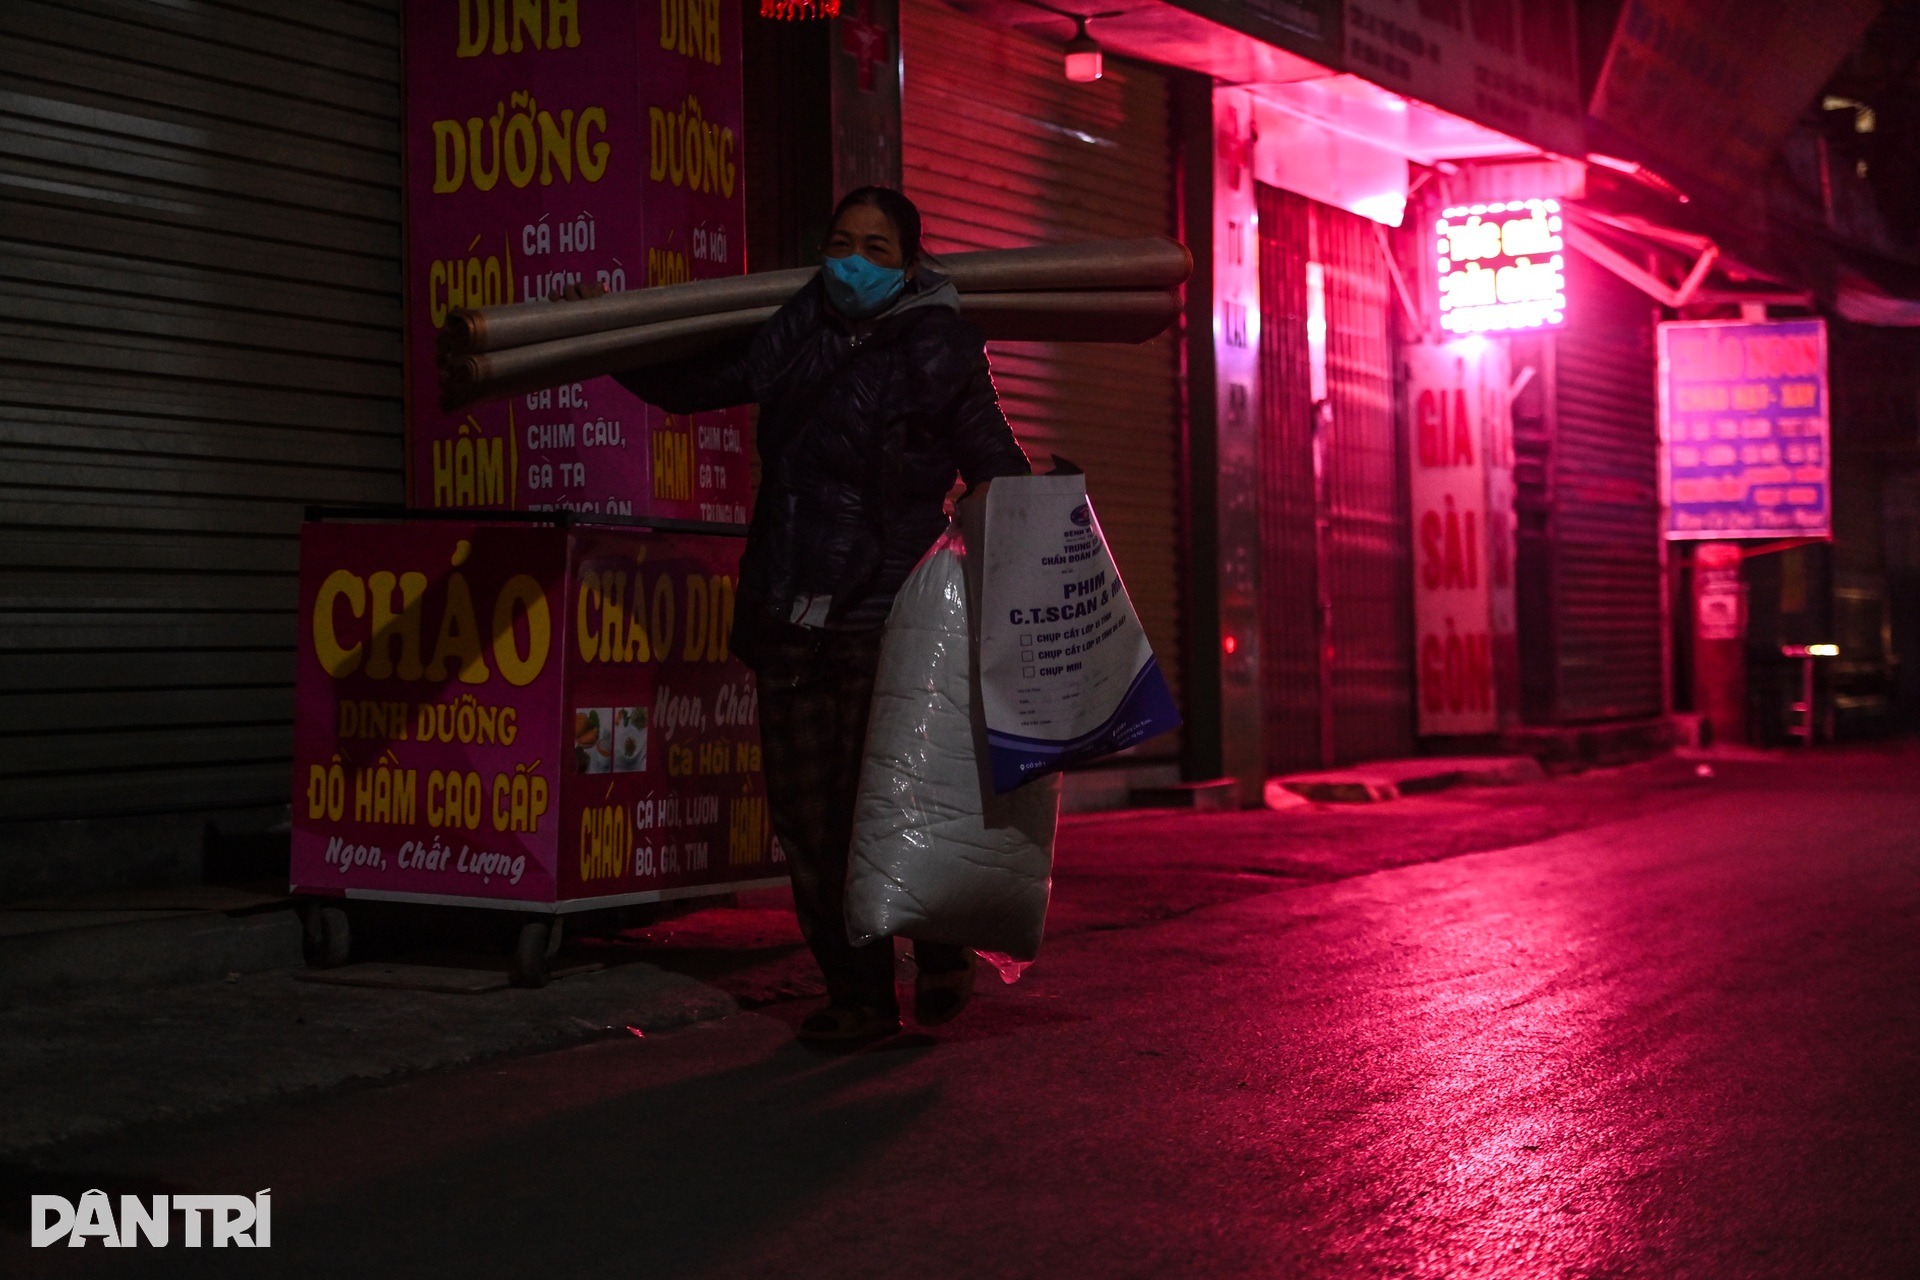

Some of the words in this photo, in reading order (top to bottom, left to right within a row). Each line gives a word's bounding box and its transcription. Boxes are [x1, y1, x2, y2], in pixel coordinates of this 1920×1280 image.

[432, 89, 611, 194] DƯỠNG
[649, 94, 736, 199] DƯỠNG
[522, 212, 550, 256] CÁ
[559, 210, 596, 252] HỒI
[693, 220, 707, 260] CÁ
[527, 423, 576, 450] CHIM
[583, 416, 626, 449] CÂU,
[433, 414, 505, 508] HẦM
[528, 455, 553, 490] GÀ
[559, 462, 586, 488] TA
[713, 465, 726, 490] TA
[1064, 542, 1091, 554] TRUNG
[577, 544, 676, 664] CHÁO
[683, 573, 738, 664] DIN
[1064, 570, 1105, 599] PHIM
[312, 539, 550, 687] CHÁO
[1010, 596, 1097, 625] C.T.SCAN
[1101, 590, 1109, 606] &
[1037, 633, 1061, 643] CHỤP
[1038, 649, 1062, 660] CHỤP
[1039, 666, 1064, 676] CHỤP
[1066, 661, 1082, 673] MRI
[339, 700, 408, 741] DINH
[416, 693, 518, 746] DƯỠNG
[653, 685, 707, 741] Ngon,
[306, 747, 348, 822] ĐỒ
[355, 748, 417, 826] HẦM
[427, 769, 482, 831] CAO
[492, 759, 549, 833] CẤP
[636, 790, 654, 830] CÁ
[579, 780, 625, 882] CHÁO
[325, 836, 387, 874] Ngon,
[398, 835, 450, 872] Chất
[456, 844, 526, 886] Lượng
[635, 836, 657, 878] BÒ,
[684, 842, 708, 872] TIM
